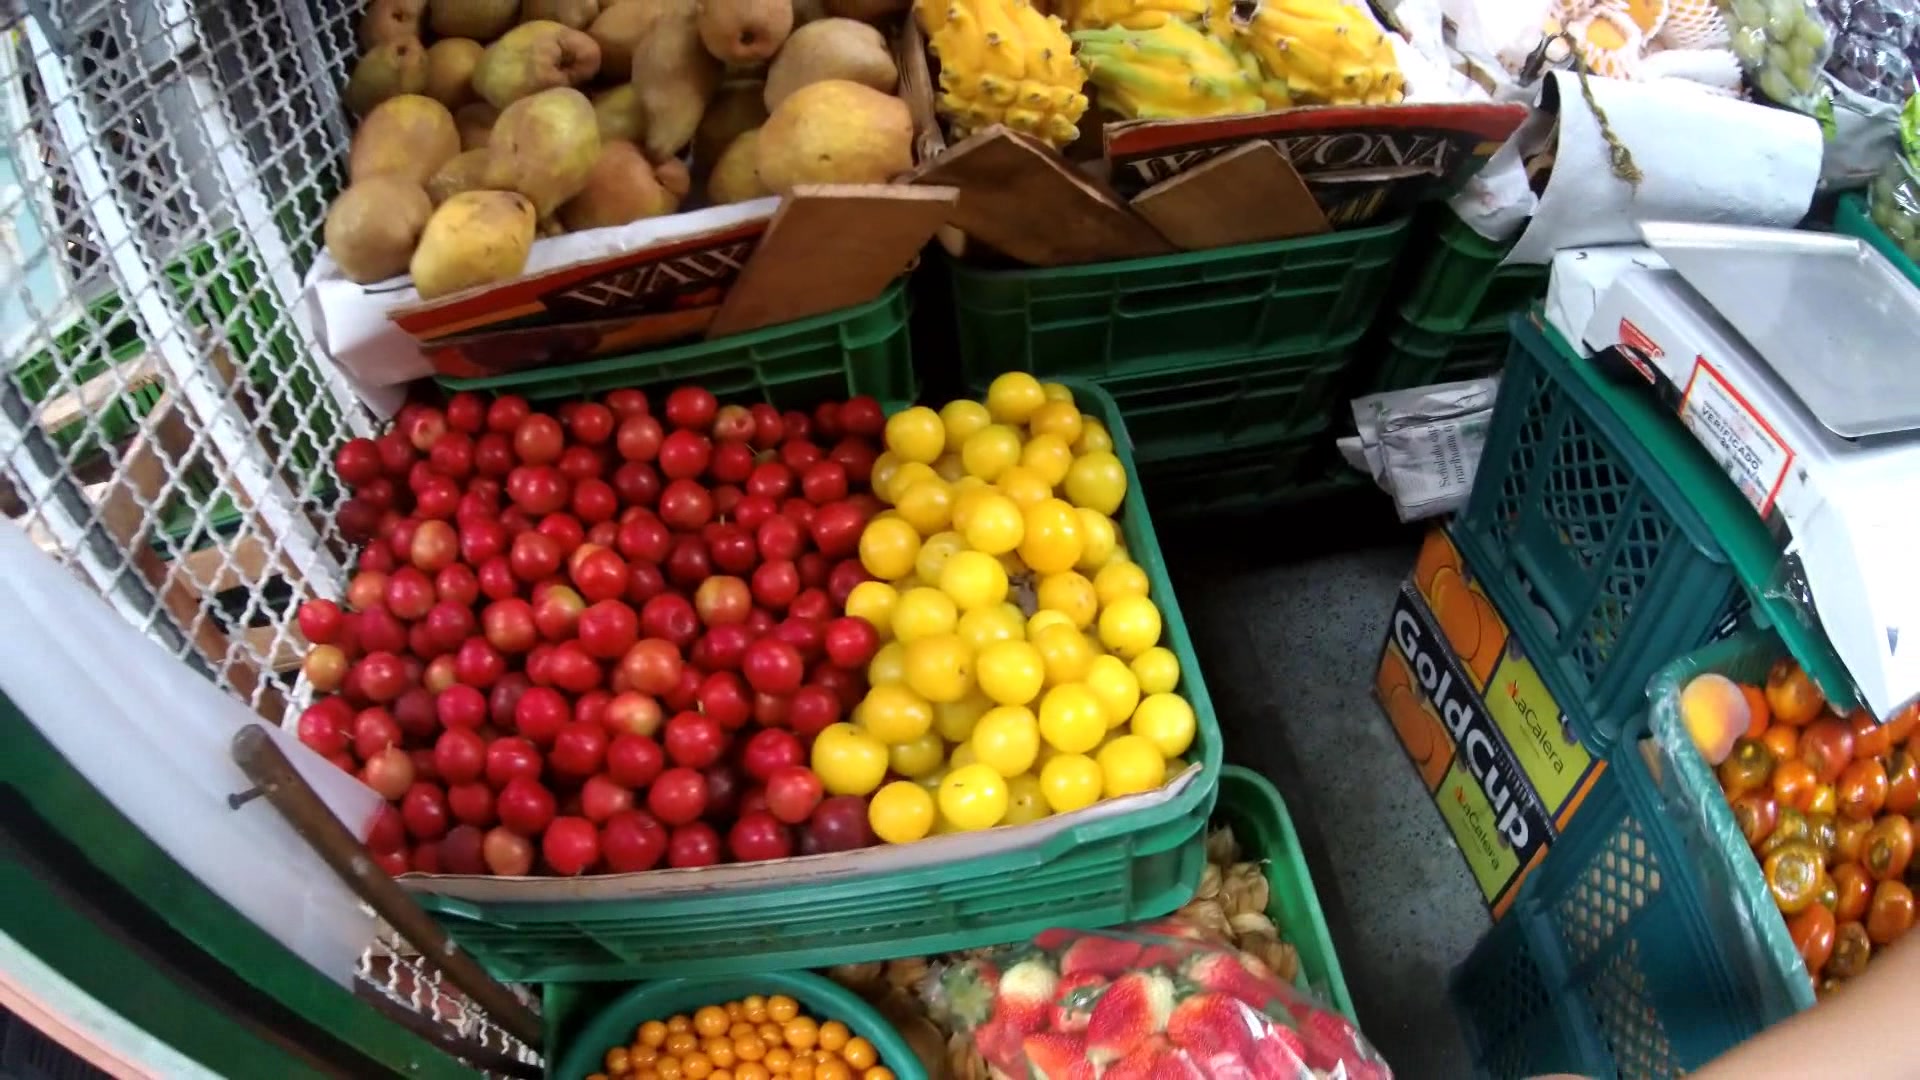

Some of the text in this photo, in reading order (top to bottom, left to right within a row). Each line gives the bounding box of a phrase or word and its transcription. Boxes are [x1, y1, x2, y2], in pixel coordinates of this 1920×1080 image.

[1701, 405, 1759, 470] VERIFICADO
[1394, 608, 1529, 849] GoldCup
[1510, 680, 1564, 775] LaCalera
